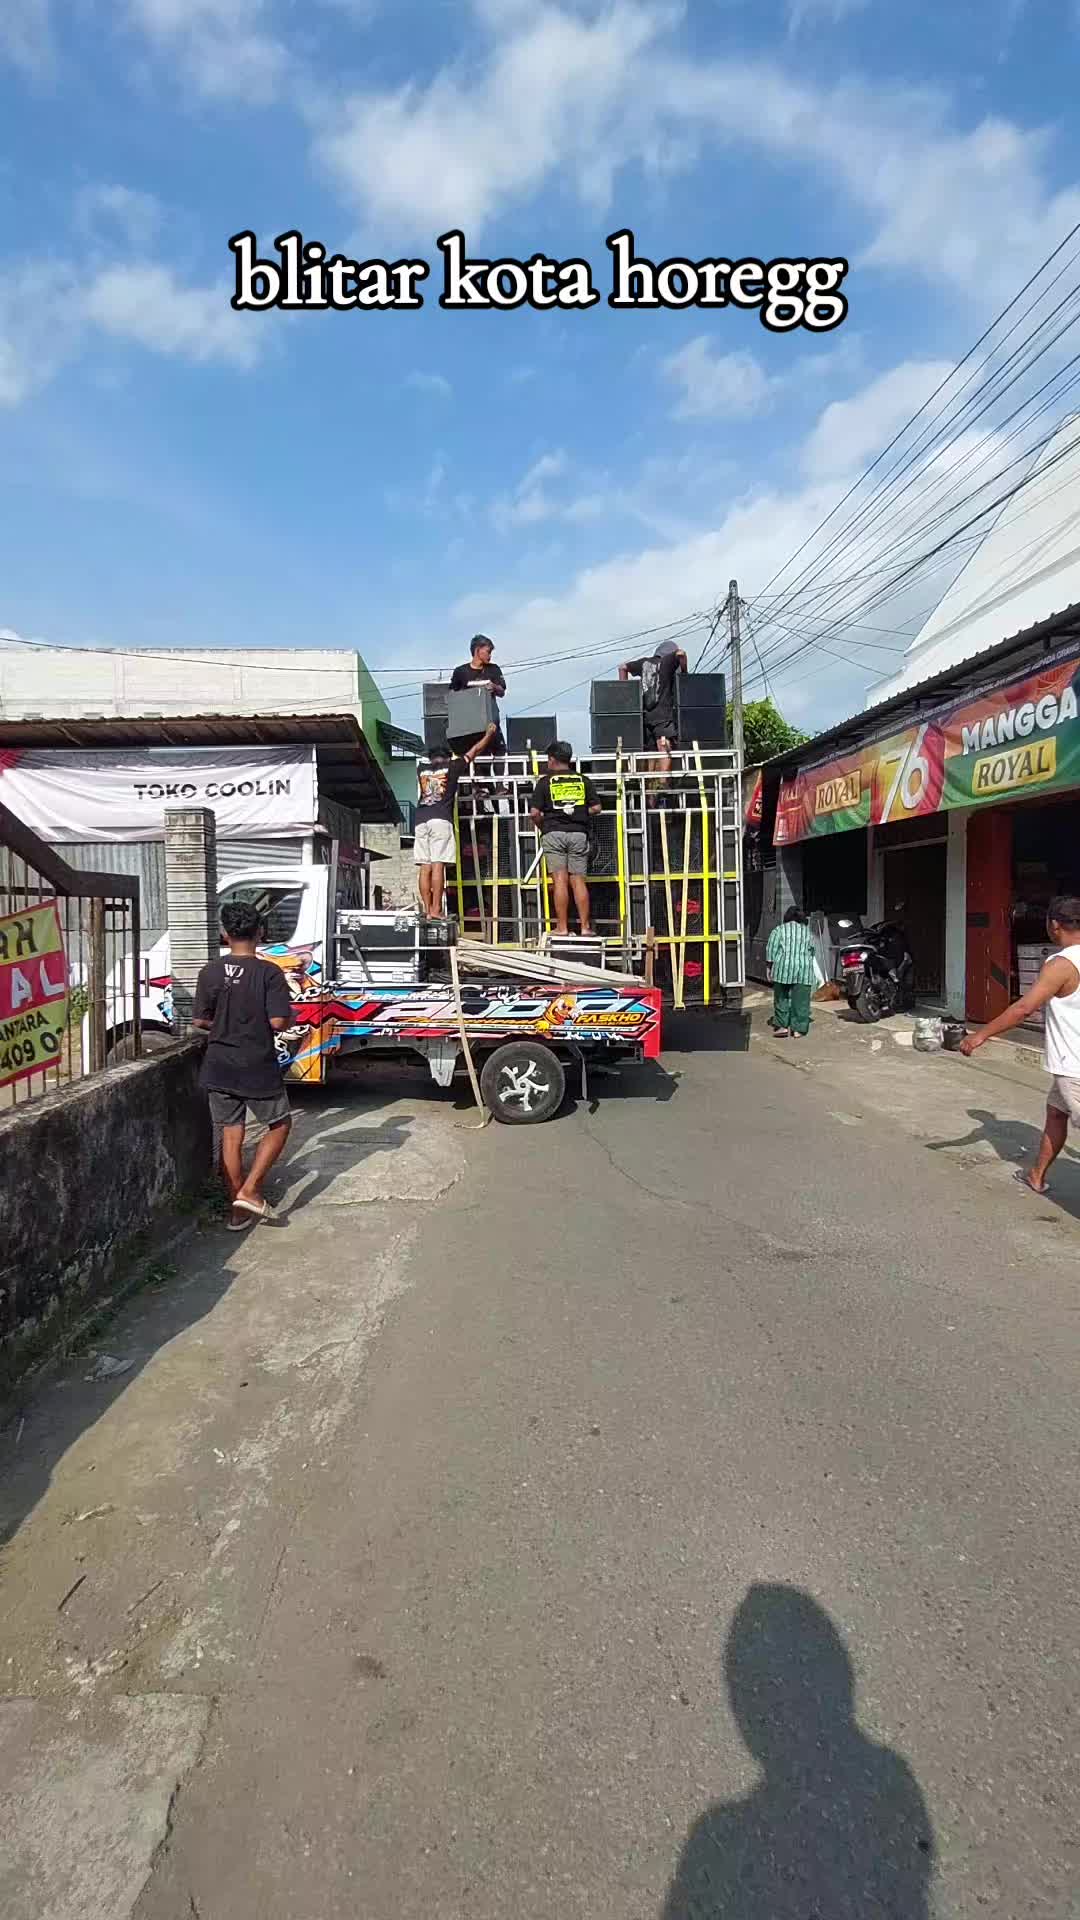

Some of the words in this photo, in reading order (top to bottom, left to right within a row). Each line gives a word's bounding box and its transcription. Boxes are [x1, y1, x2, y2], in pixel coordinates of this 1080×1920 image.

[962, 686, 1078, 756] MANGGA
[880, 722, 929, 824] 76
[977, 745, 1050, 789] ROYAL
[134, 783, 197, 800] TOKO
[817, 777, 858, 809] ROYAL
[576, 1013, 641, 1023] FASKHO
